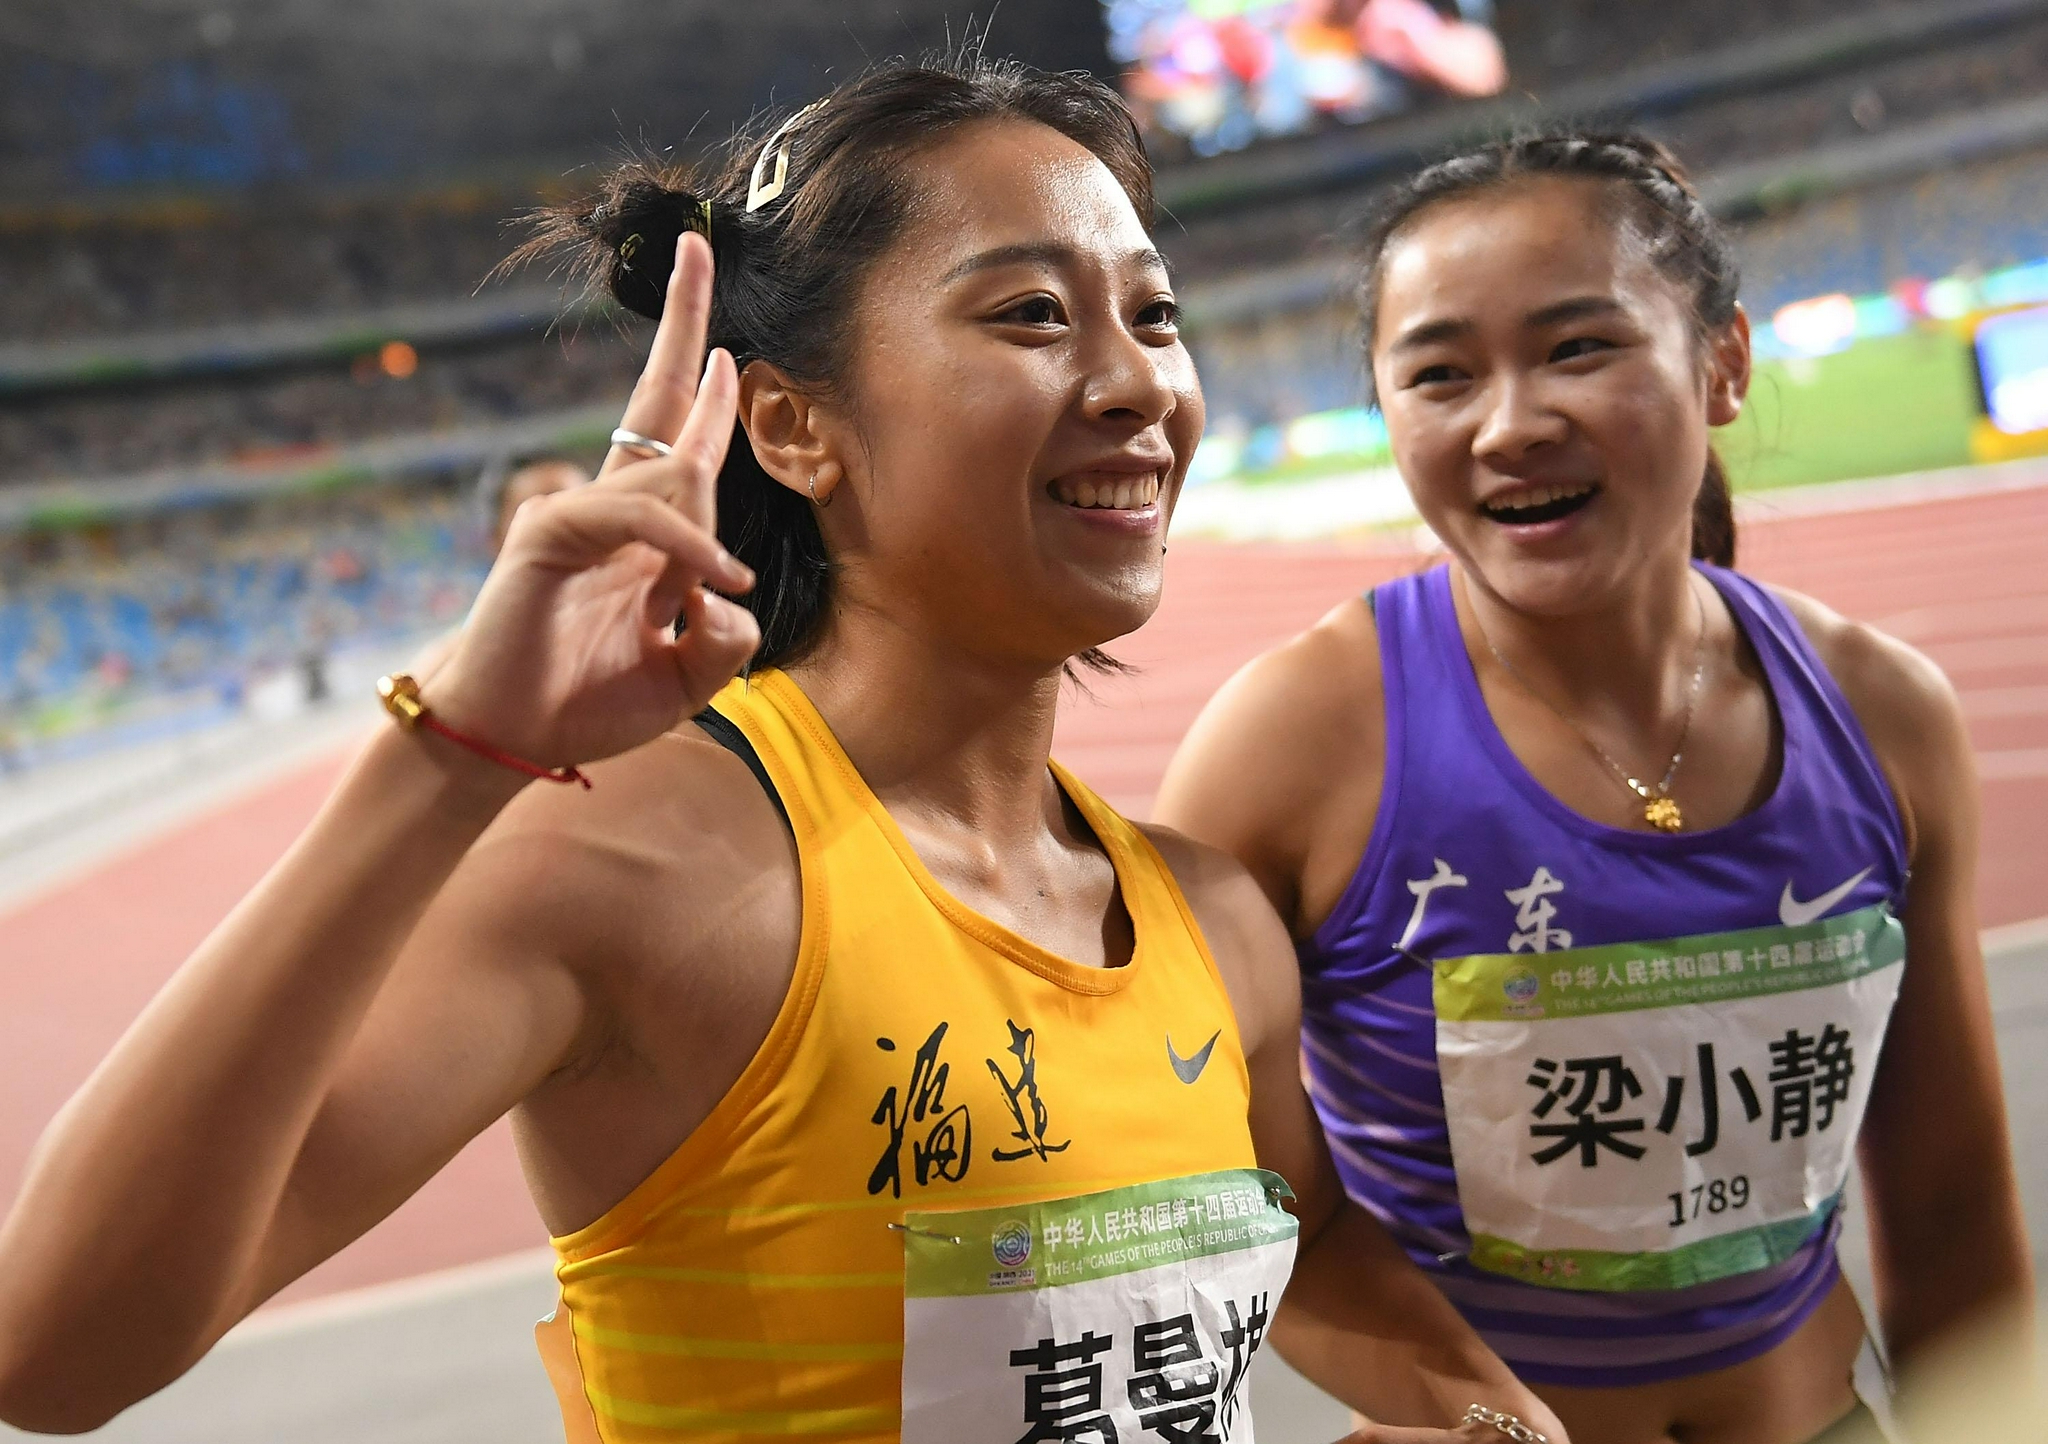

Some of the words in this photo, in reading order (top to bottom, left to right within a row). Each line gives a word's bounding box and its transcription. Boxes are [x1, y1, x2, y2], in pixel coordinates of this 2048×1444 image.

[1397, 857, 1573, 953] 广东
[867, 1018, 1071, 1198] 福建
[1526, 1022, 1855, 1167] 梁小静
[1043, 1187, 1266, 1253] 中华人民共和国第十四届运动会
[1668, 1174, 1750, 1228] 1789
[1044, 1261, 1070, 1277] THE
[1090, 1250, 1126, 1269] GAMES
[1127, 1246, 1140, 1262] OF
[1140, 1242, 1160, 1258] THE
[1161, 1235, 1201, 1254] PEOPLE'S
[1203, 1227, 1247, 1246] REPUBLIC
